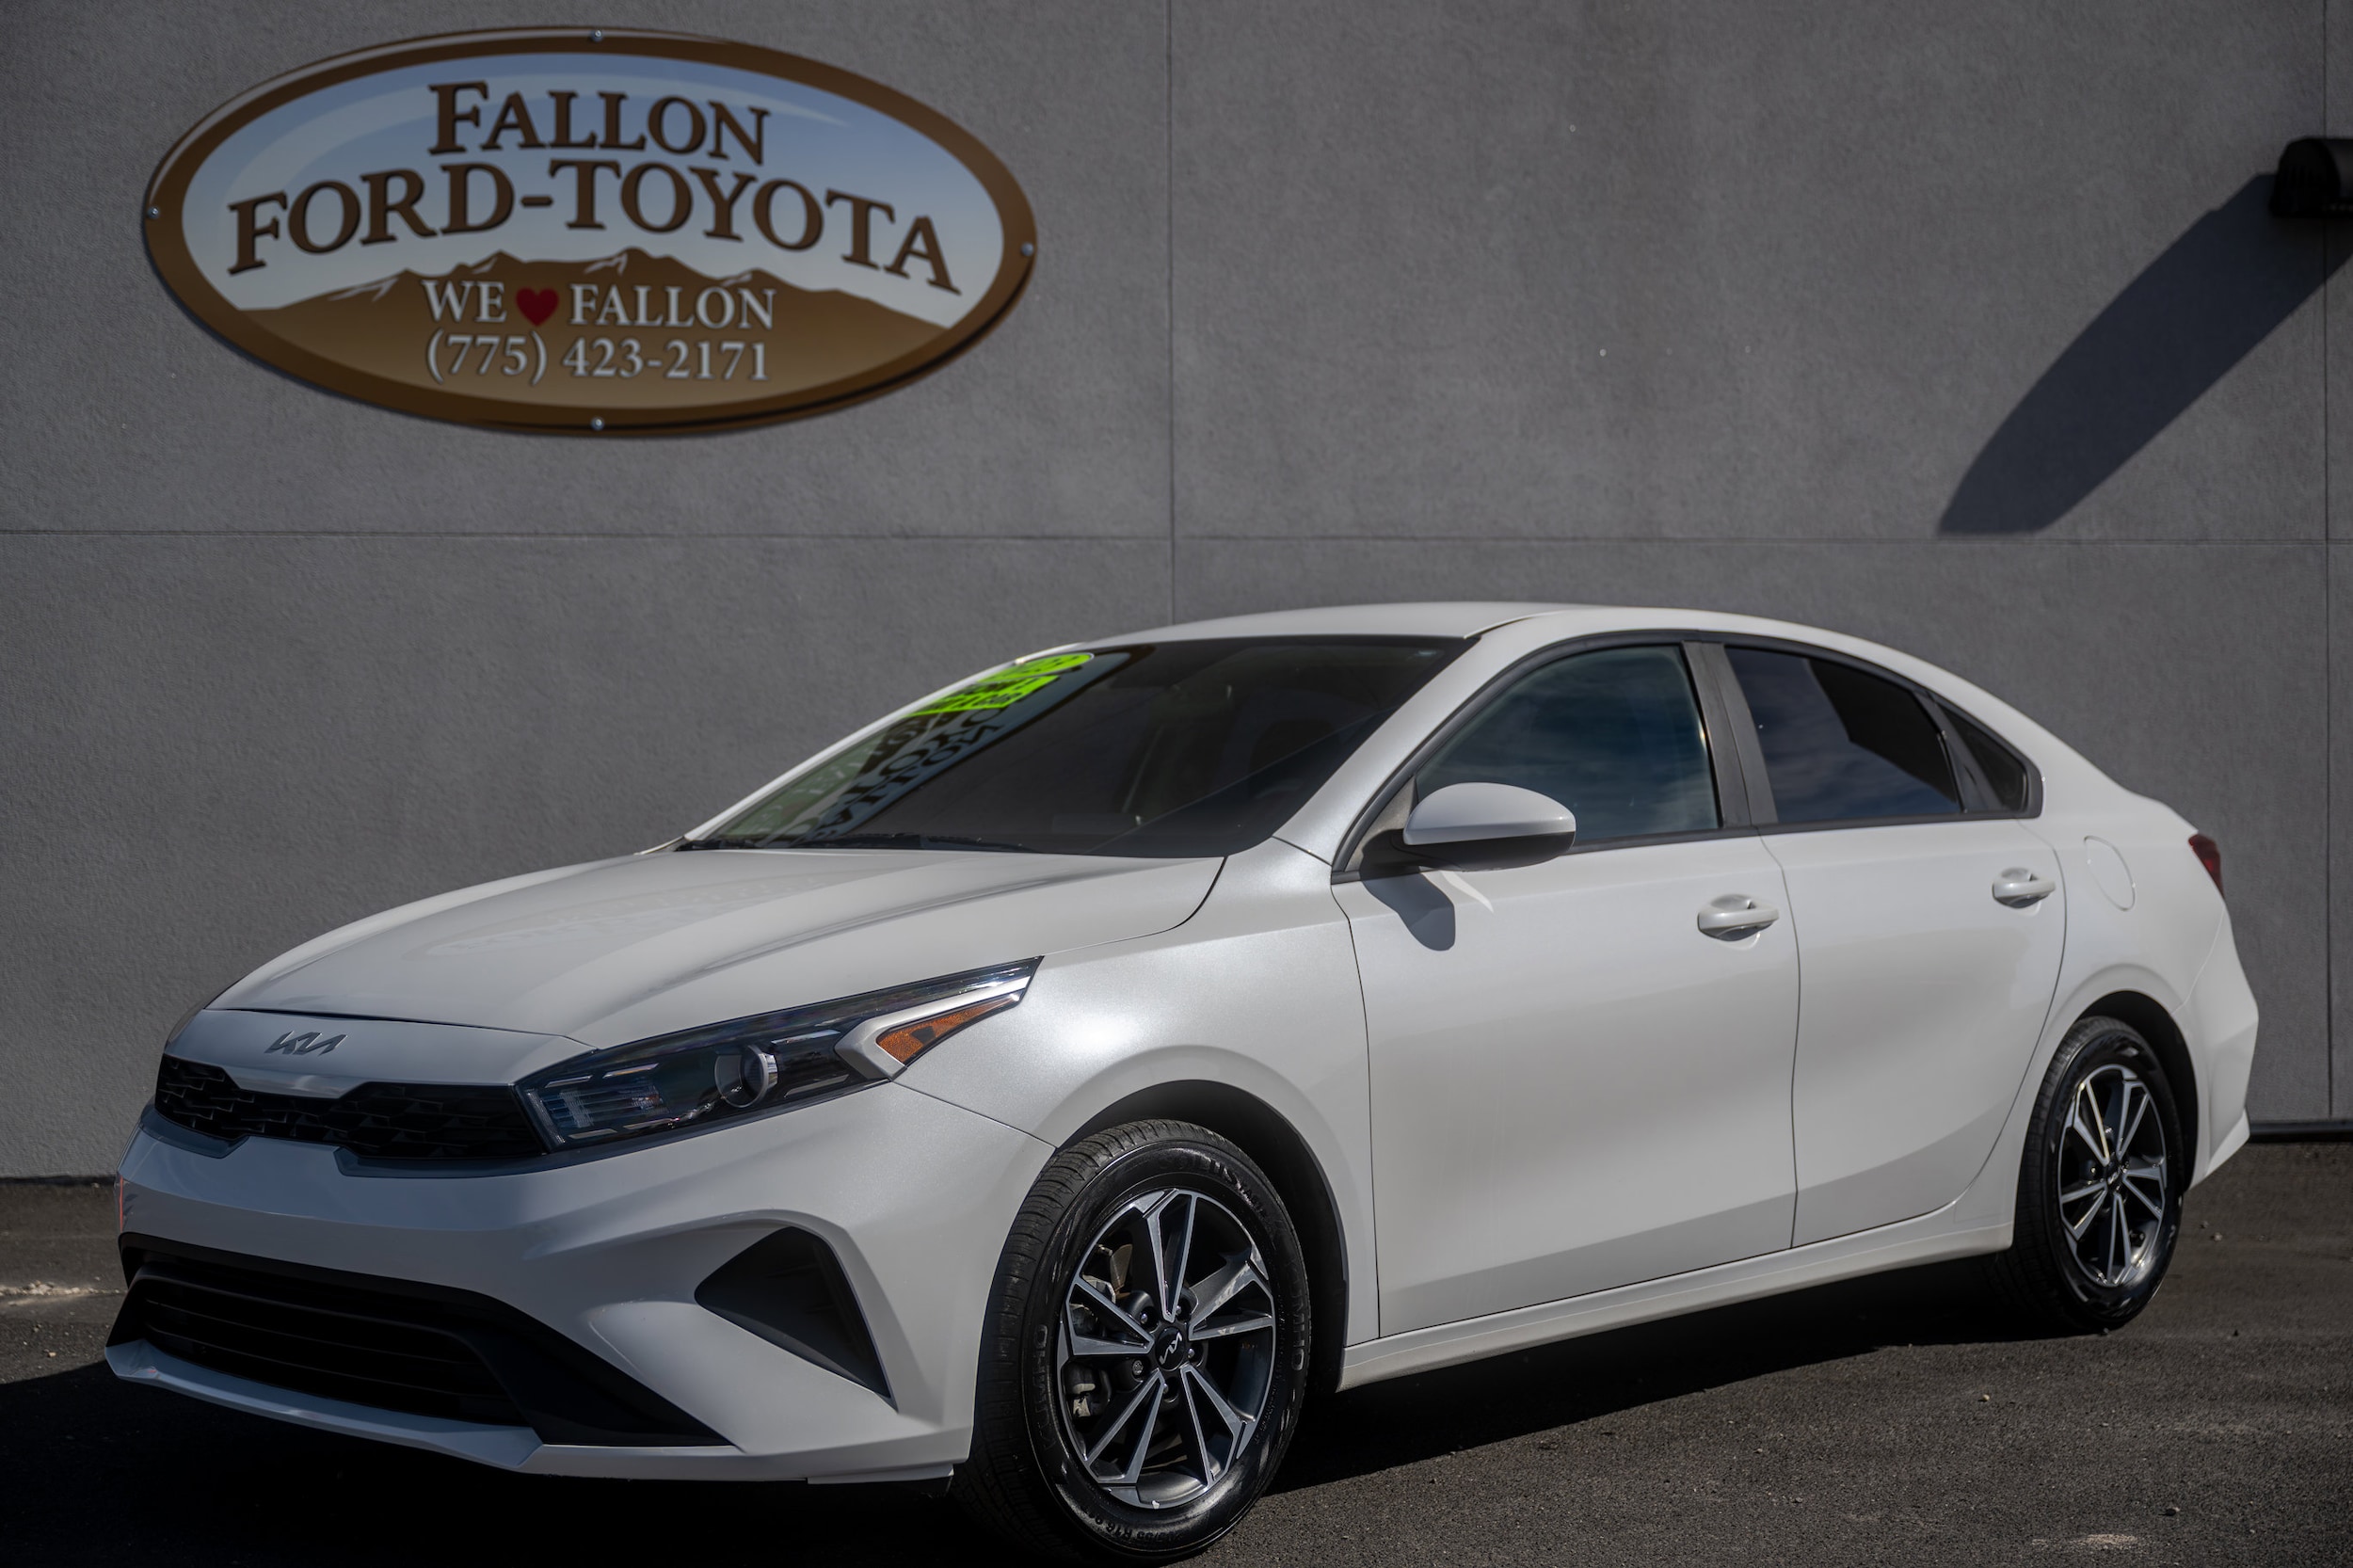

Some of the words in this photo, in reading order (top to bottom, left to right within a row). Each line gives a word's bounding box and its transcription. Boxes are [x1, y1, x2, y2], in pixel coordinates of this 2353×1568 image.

[427, 80, 772, 168] FALLON
[227, 158, 964, 297] FORD-TOYOTA
[422, 279, 507, 325] WE
[569, 282, 778, 332] FALLON
[426, 329, 549, 385] (775)
[562, 336, 772, 384] 423-2171
[264, 1030, 349, 1056] KIA
